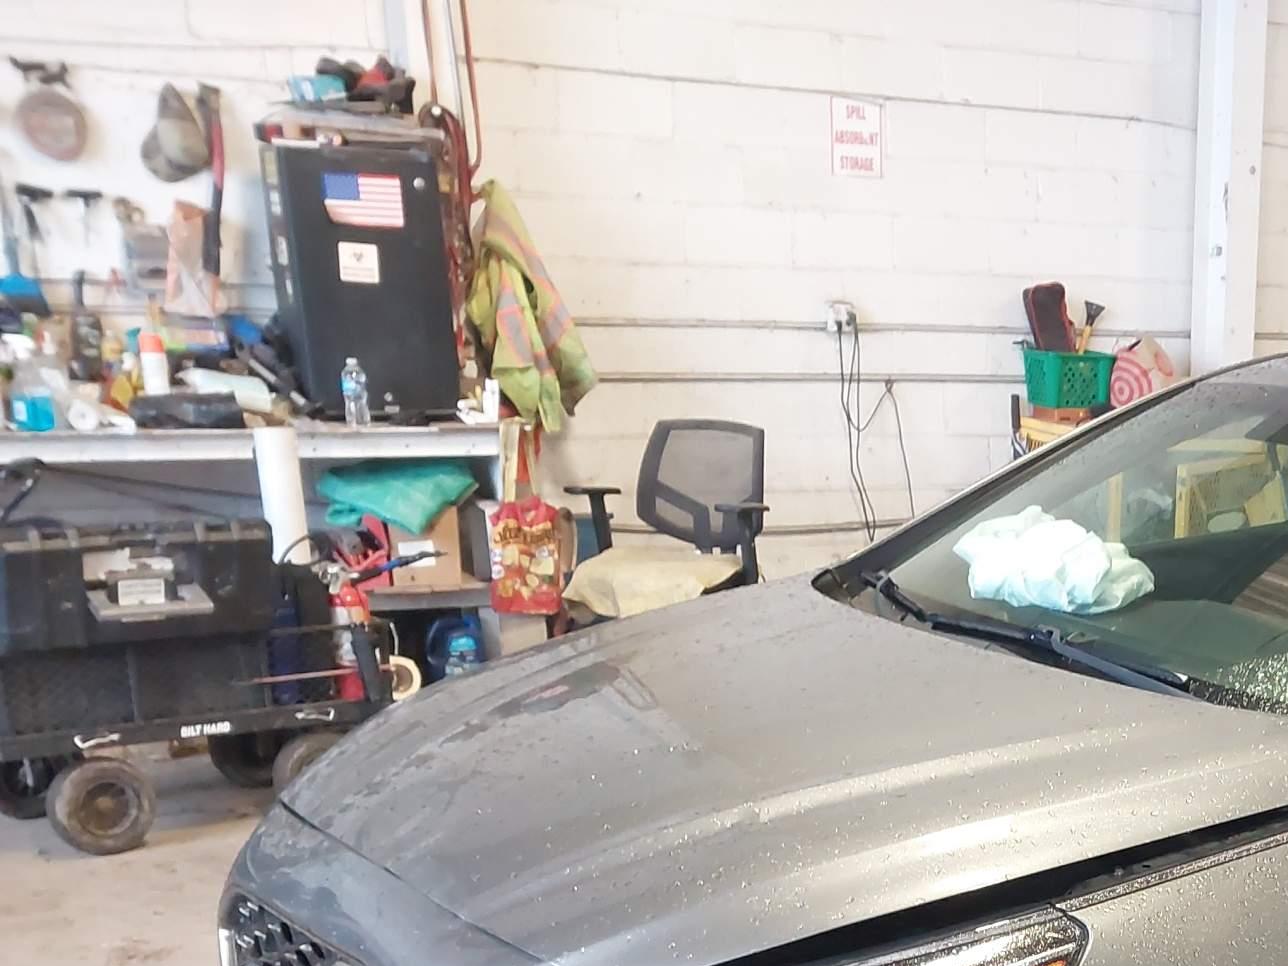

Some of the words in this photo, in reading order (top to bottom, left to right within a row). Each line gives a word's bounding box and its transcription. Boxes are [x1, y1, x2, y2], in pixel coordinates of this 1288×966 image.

[846, 104, 866, 120] SPILL
[840, 155, 875, 172] STORAGE
[203, 720, 230, 736] HARD
